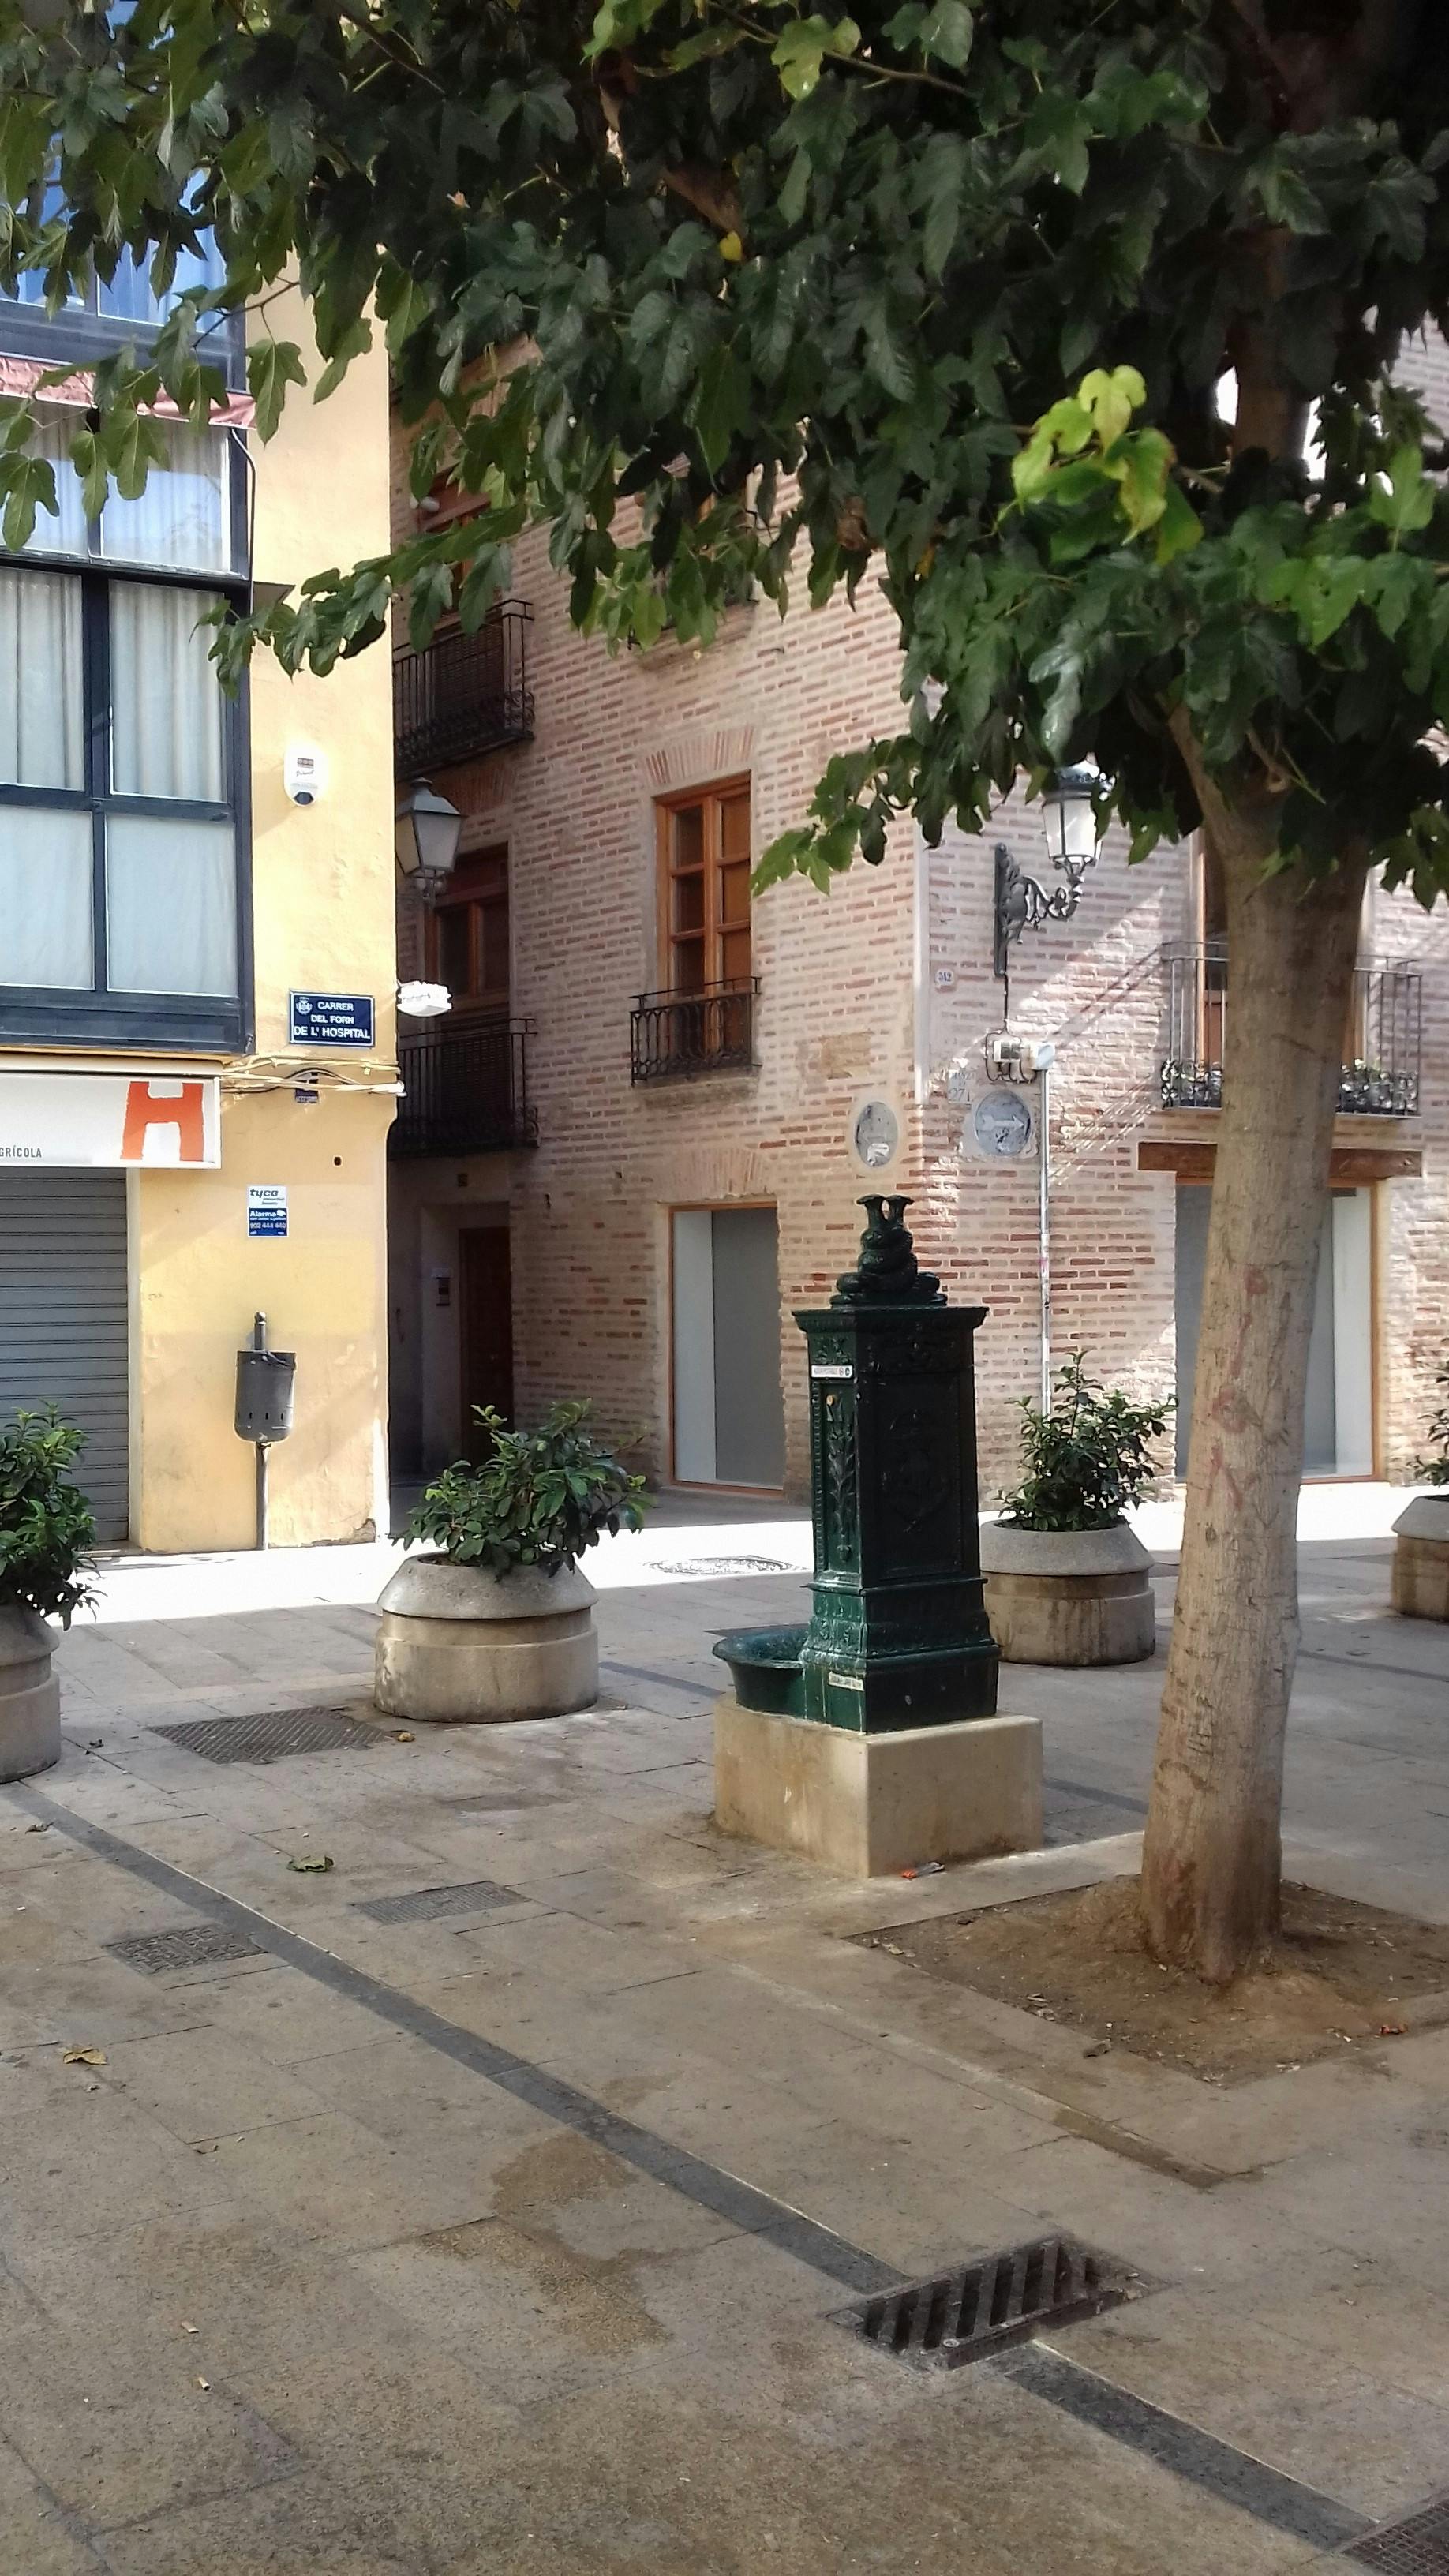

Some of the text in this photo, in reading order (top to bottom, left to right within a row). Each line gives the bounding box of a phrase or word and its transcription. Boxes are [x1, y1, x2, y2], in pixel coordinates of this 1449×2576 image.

[317, 1001, 354, 1011] CARRER
[310, 1014, 354, 1024] DEL FORN
[294, 1025, 370, 1039] DE L' HOSPITAL
[249, 1189, 279, 1198] tyco
